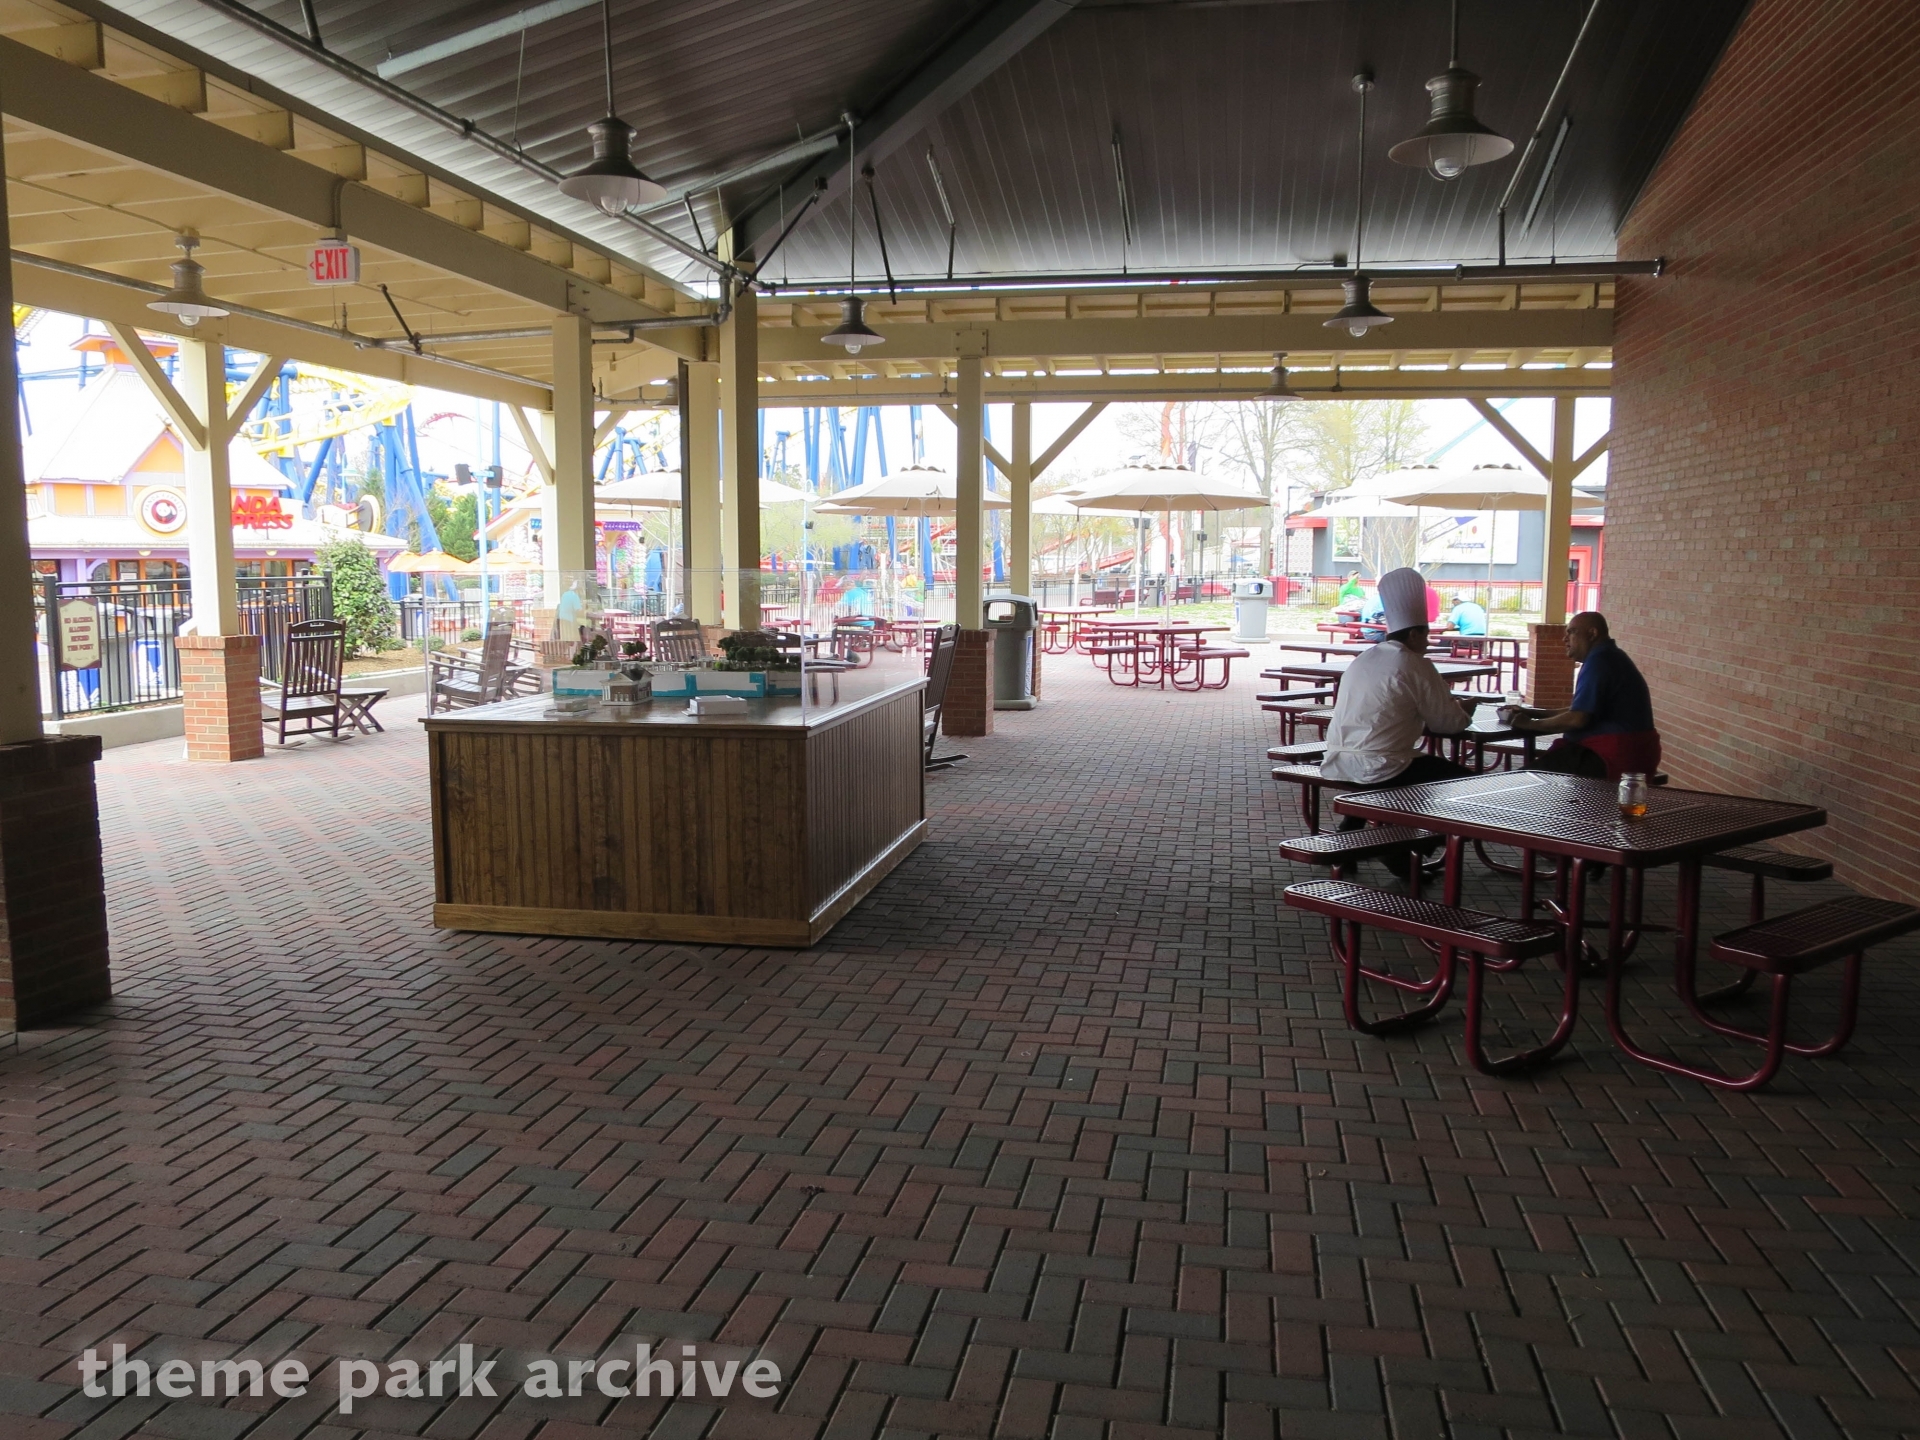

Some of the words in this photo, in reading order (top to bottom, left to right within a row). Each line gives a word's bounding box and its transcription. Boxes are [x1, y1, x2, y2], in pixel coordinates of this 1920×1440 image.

[314, 248, 348, 280] EXIT
[232, 495, 282, 514] NDA
[232, 513, 294, 530] PRESS
